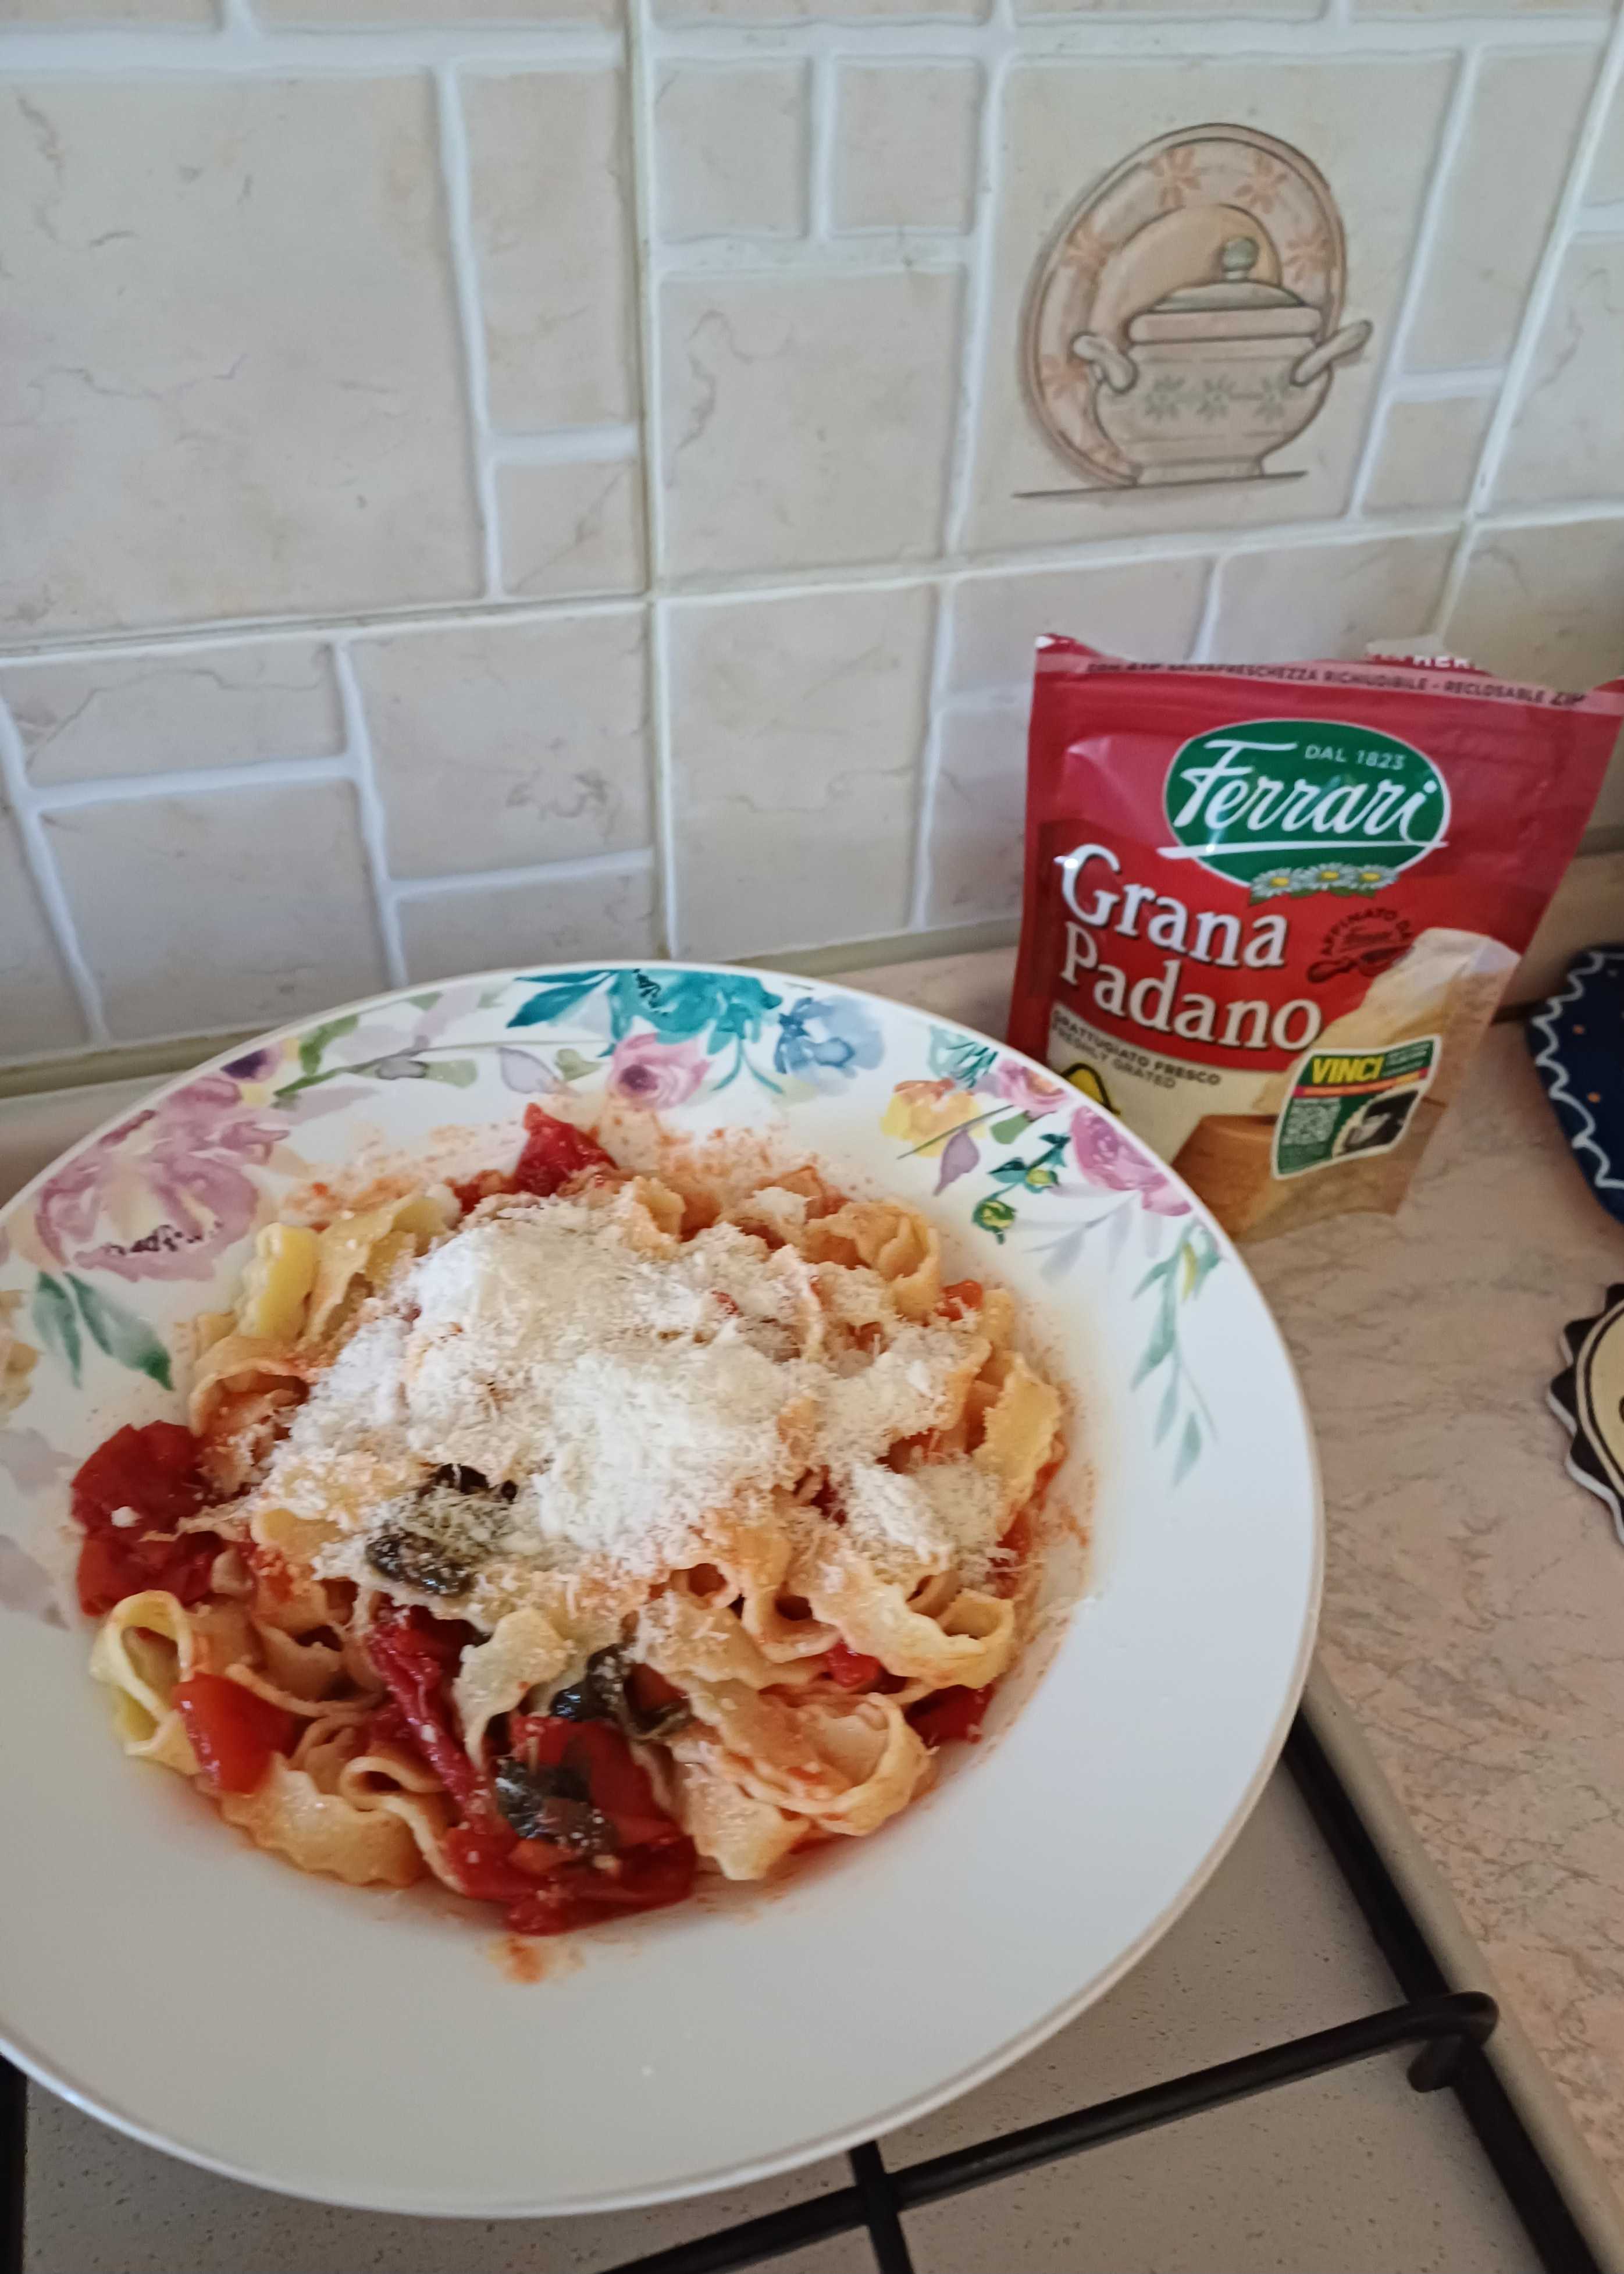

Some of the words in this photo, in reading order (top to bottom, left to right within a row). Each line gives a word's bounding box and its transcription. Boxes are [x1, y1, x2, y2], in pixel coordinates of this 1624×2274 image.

[1324, 670, 1428, 691] RICHIUDIBILE
[1444, 681, 1544, 703] RECLOSABLE
[1548, 691, 1587, 706] ZIP
[1304, 744, 1347, 763] DAL
[1357, 749, 1406, 770] 1823
[1163, 739, 1443, 850] Ferrari
[1060, 844, 1288, 969] Grana
[1059, 920, 1322, 1051] Padano
[1053, 1009, 1150, 1067] GRATTUGIATO
[1154, 1061, 1221, 1086] FRESCO
[1112, 1057, 1177, 1089] GRATED
[1312, 1055, 1386, 1084] VINCI
